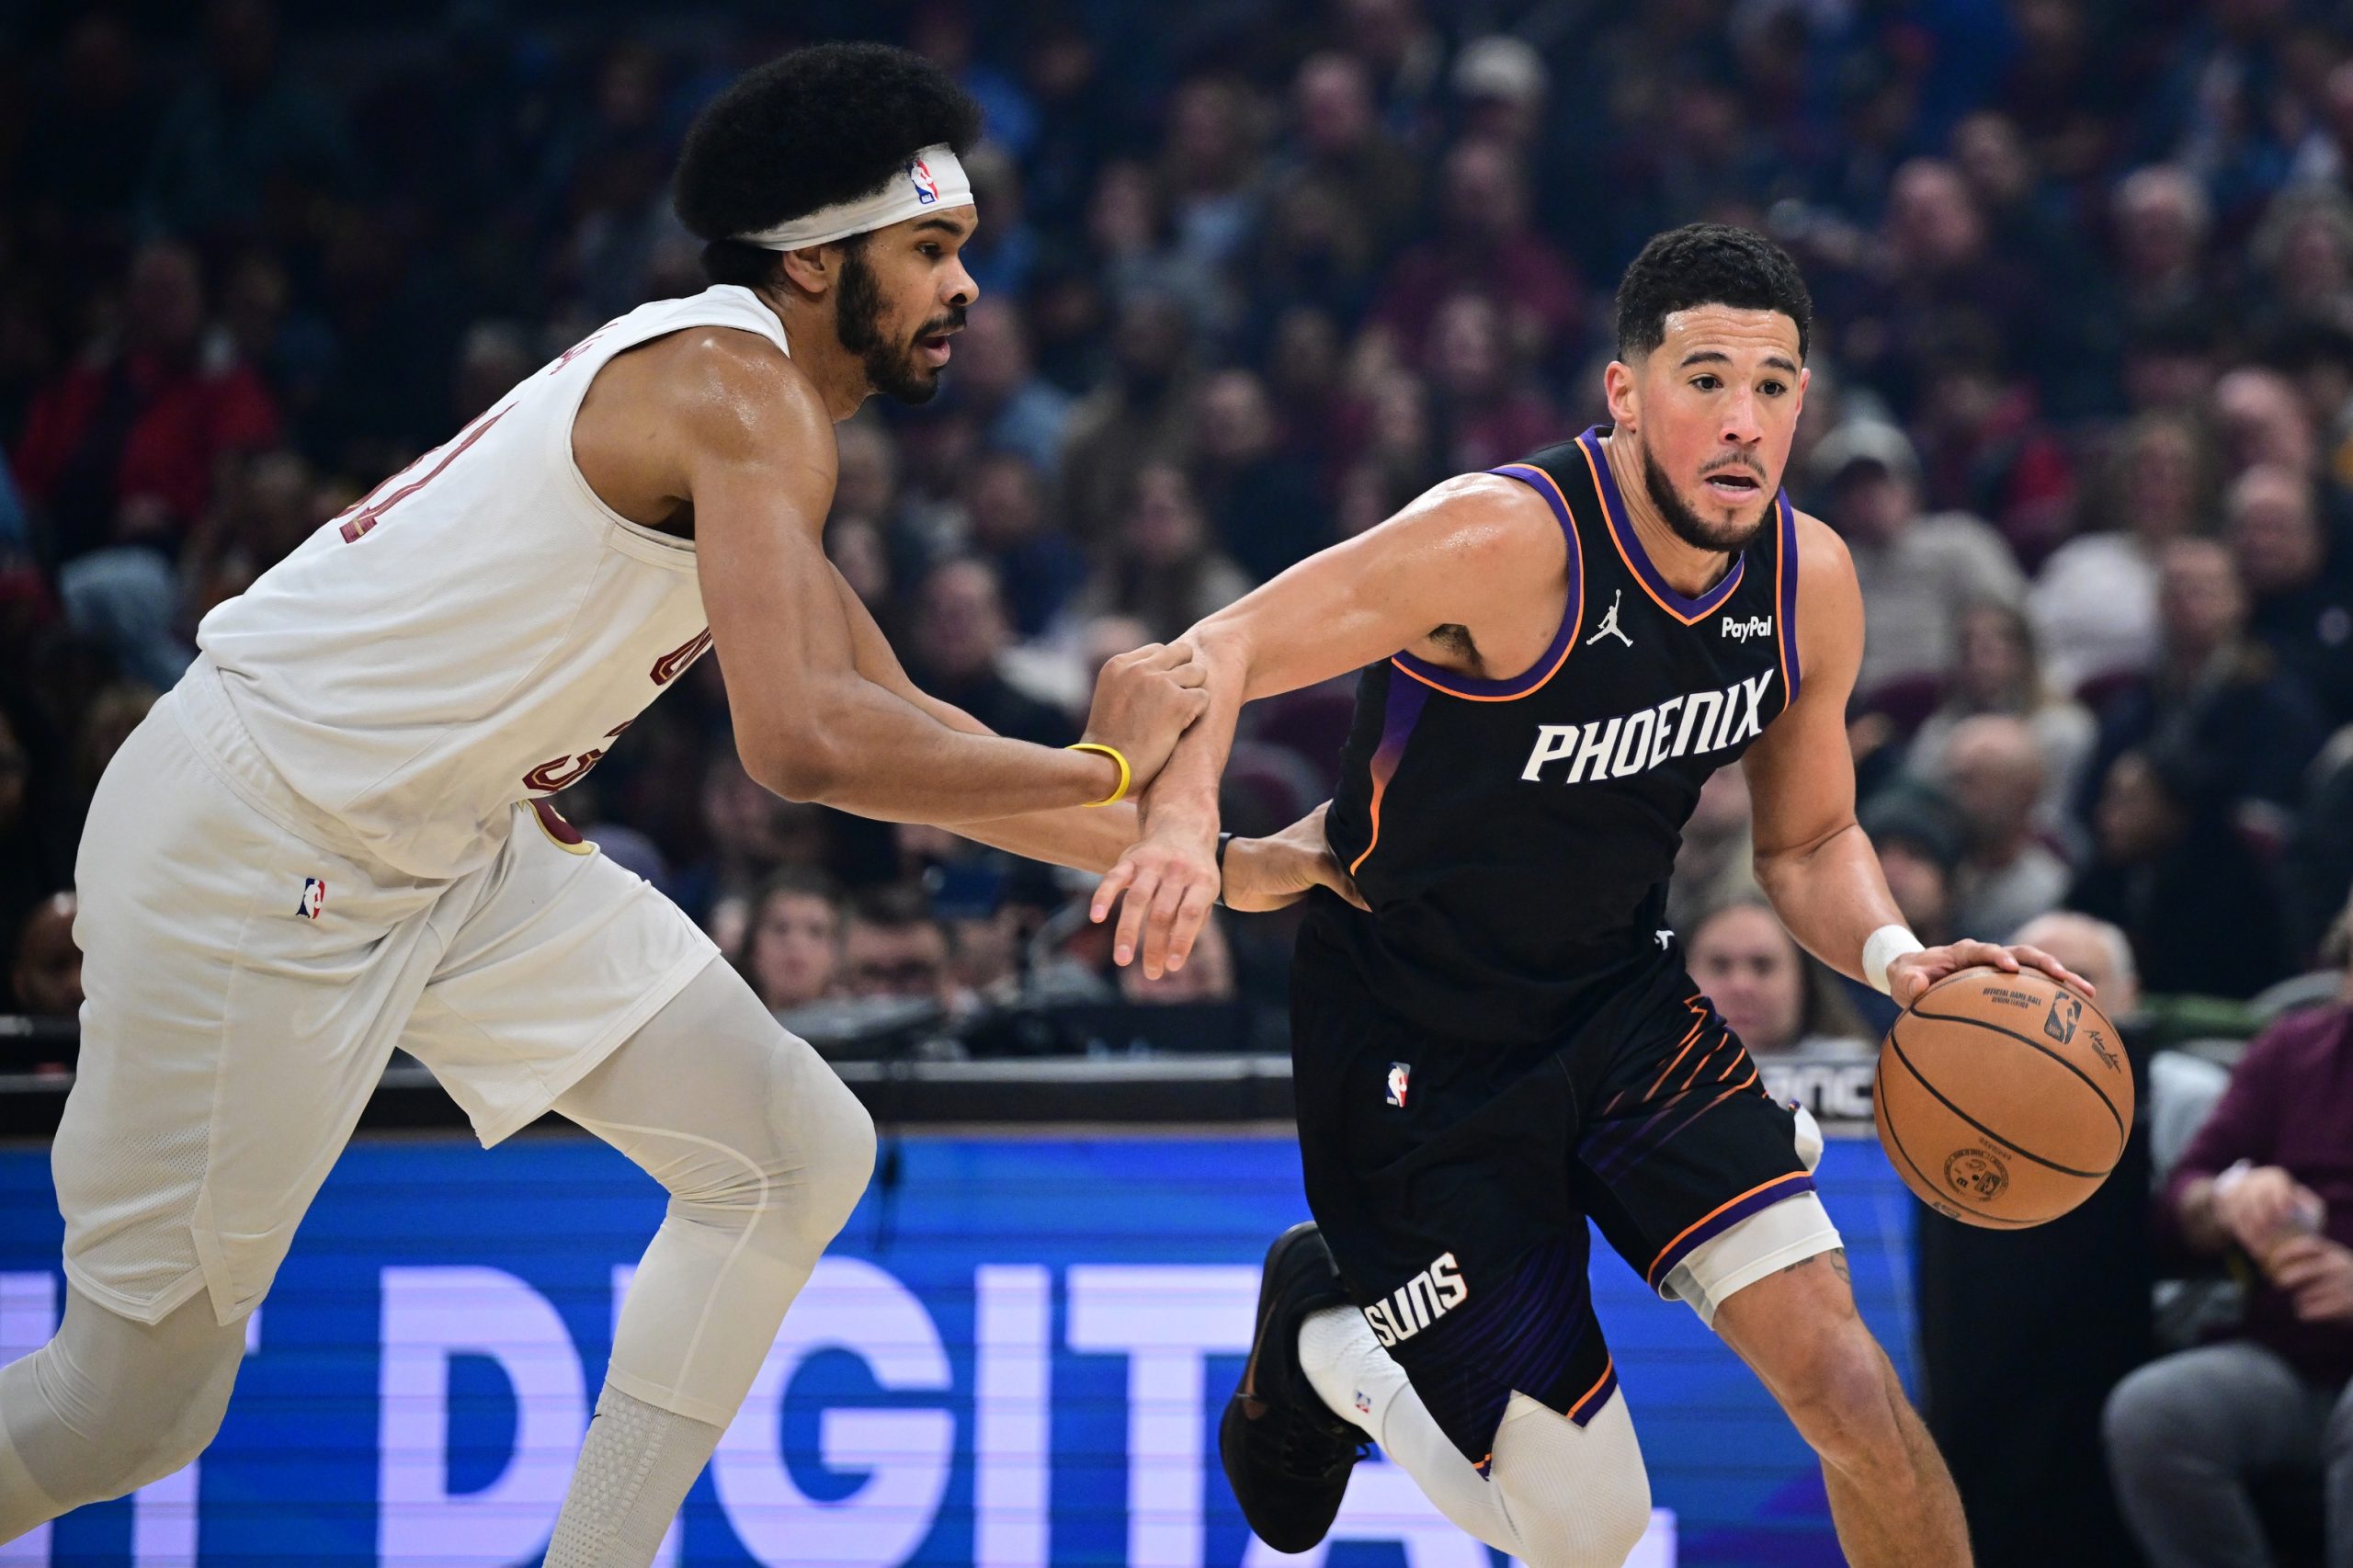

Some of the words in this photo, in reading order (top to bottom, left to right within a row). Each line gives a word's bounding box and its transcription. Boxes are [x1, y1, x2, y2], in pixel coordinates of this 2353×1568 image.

[1722, 615, 1772, 643] PayPal
[1520, 668, 1774, 784] PHOENIX
[1364, 1252, 1468, 1348] SUNS
